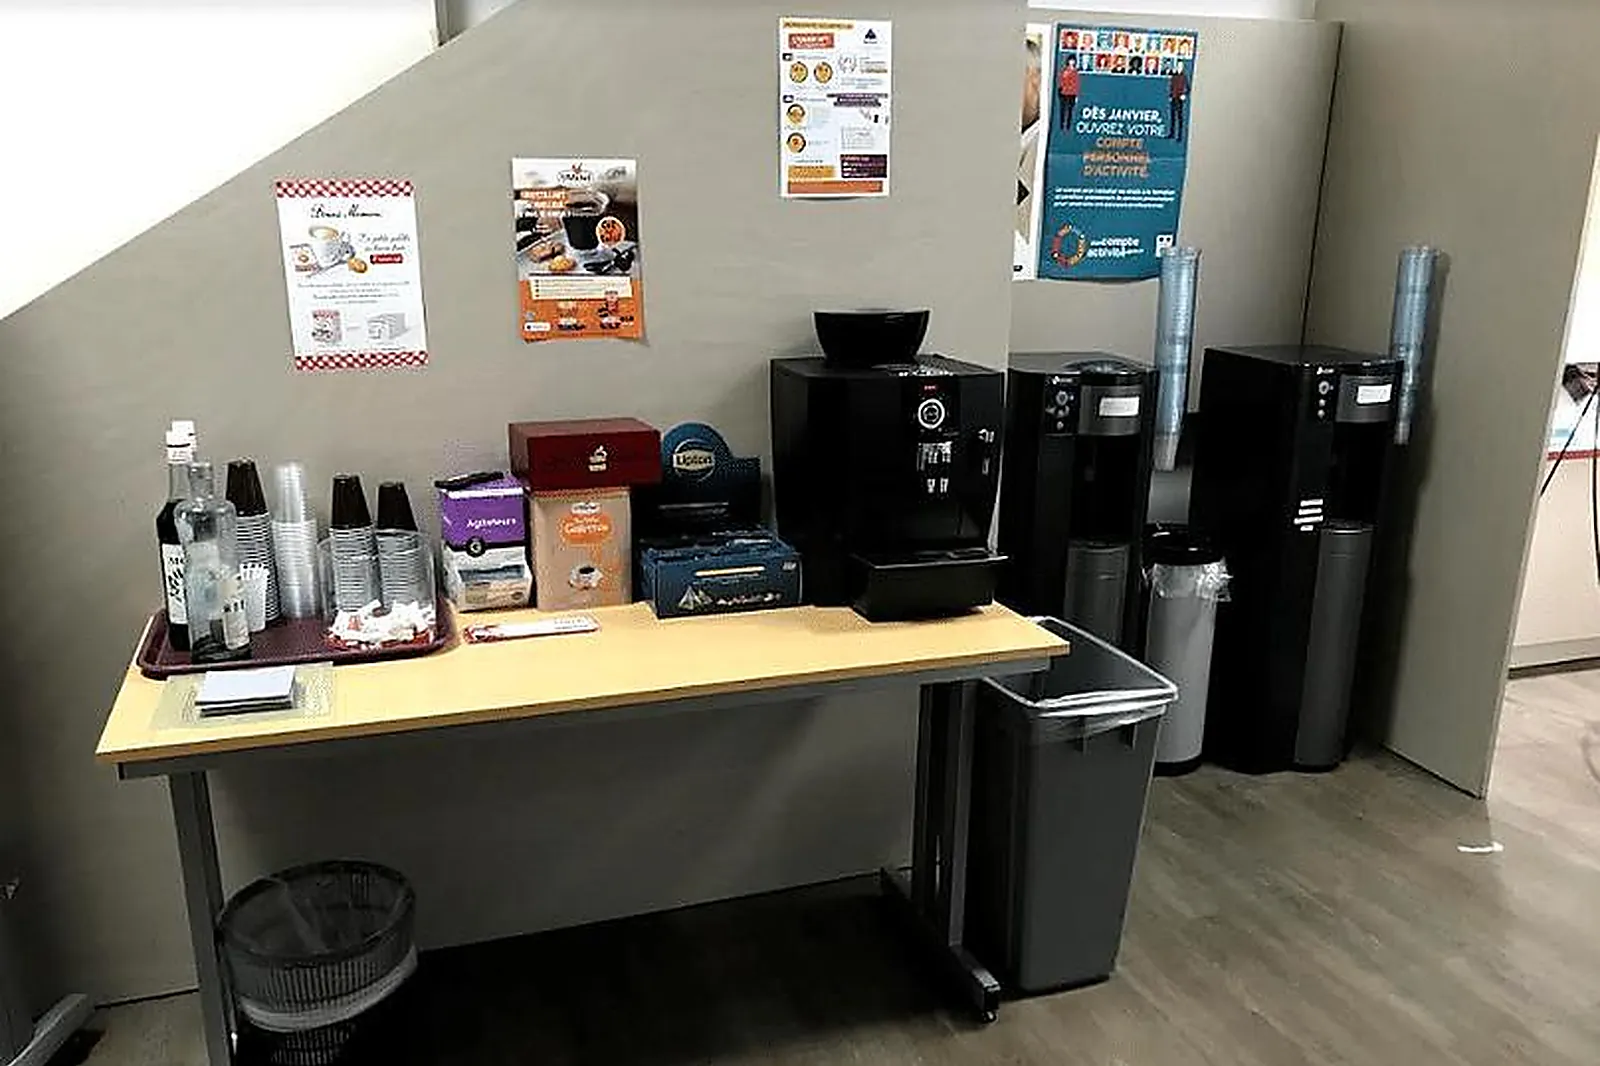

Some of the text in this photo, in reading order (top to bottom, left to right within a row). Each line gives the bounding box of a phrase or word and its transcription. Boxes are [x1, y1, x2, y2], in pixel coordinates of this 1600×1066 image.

[1082, 105, 1162, 123] DÈS JANVIER,
[1076, 121, 1167, 137] OUVREZ VOTRE
[676, 453, 712, 467] Lipton
